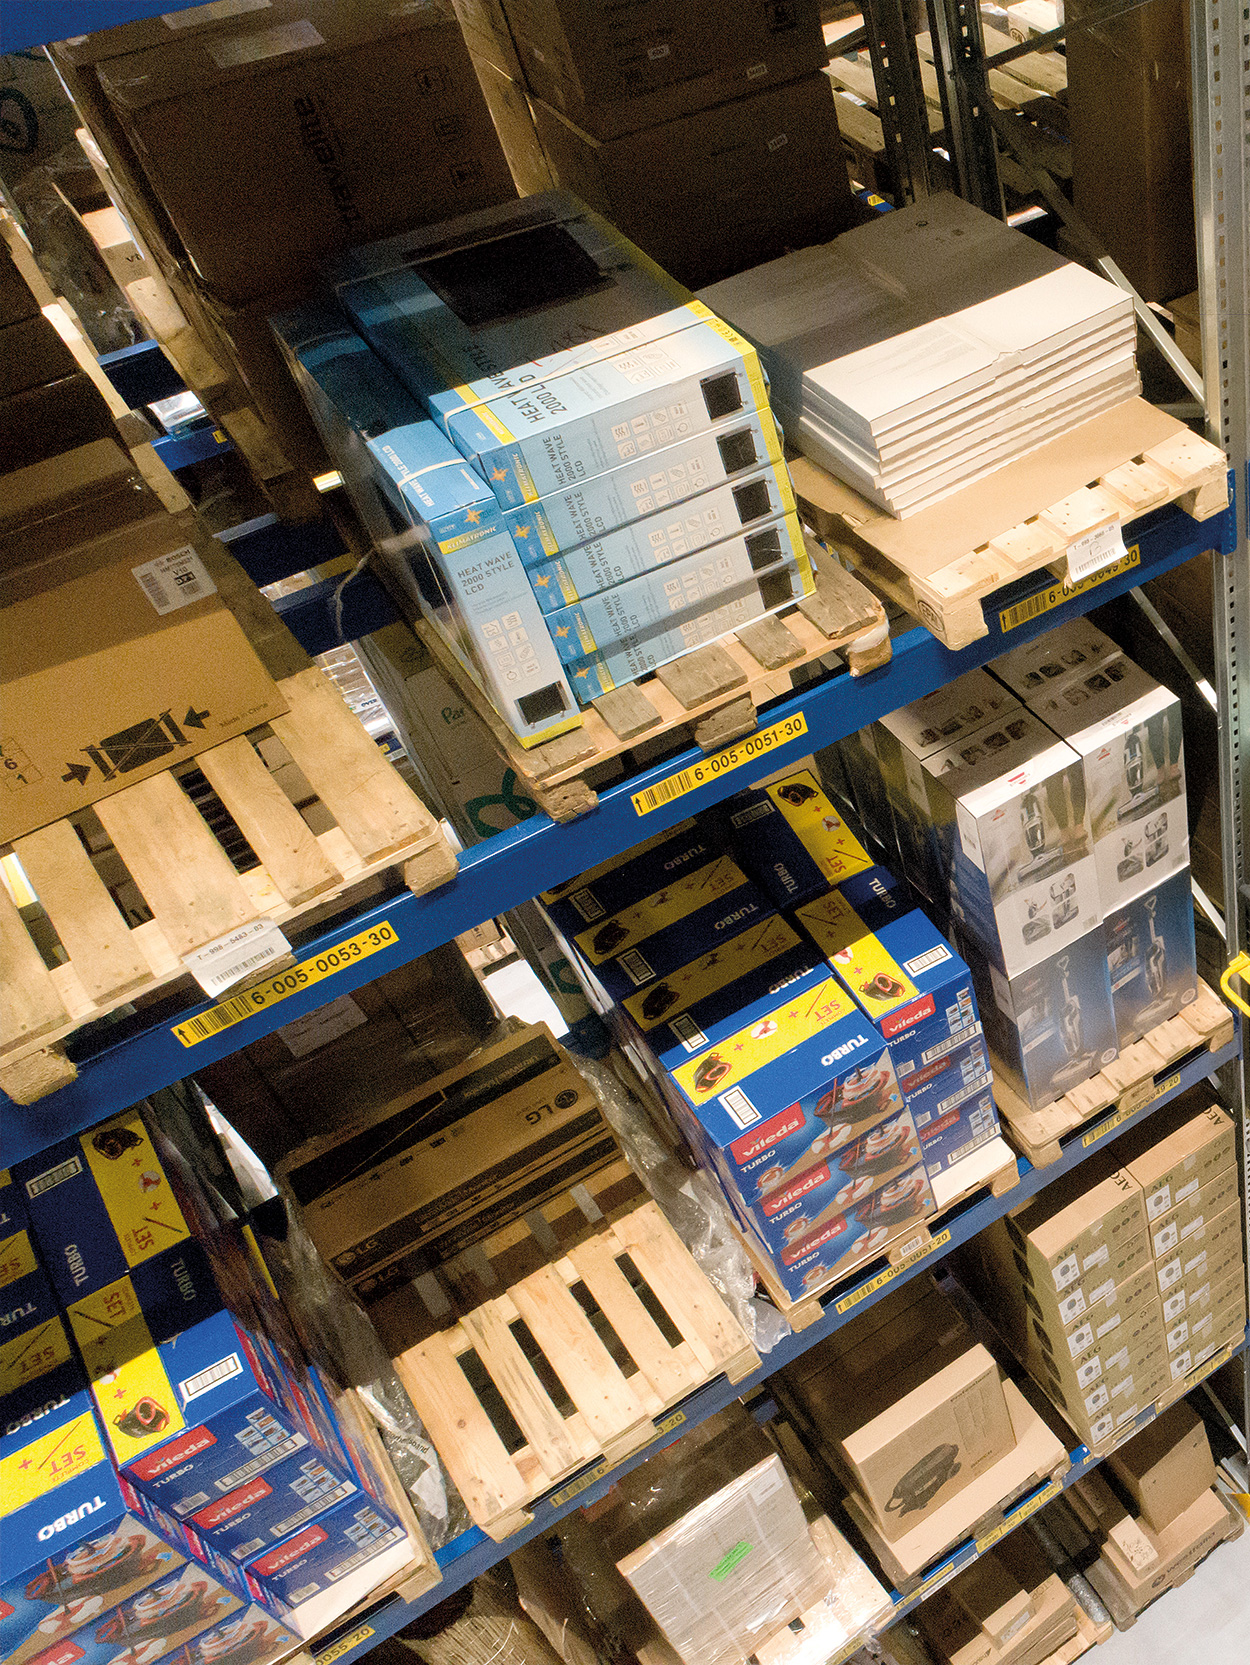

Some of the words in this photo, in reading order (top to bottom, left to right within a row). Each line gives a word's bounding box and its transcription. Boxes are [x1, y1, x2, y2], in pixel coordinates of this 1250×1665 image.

[519, 374, 546, 394] LD
[511, 397, 545, 423] HEAT
[536, 392, 568, 414] 2000
[543, 437, 557, 462] WAVE
[553, 434, 569, 461] STYLE
[552, 462, 566, 485] HEAT
[563, 463, 577, 481] 2000
[575, 461, 586, 477] LCD
[564, 494, 579, 518] WAVE
[574, 492, 589, 519] STYLE
[573, 518, 586, 540] HEAT
[584, 519, 597, 537] 2000
[594, 516, 606, 534] LCD
[447, 526, 497, 549] KLIMATRONIC
[457, 563, 482, 578] HEAT
[485, 551, 513, 567] WAVE
[584, 545, 598, 568] WAVE
[593, 542, 608, 567] STYLE
[461, 574, 484, 587] 2000
[486, 561, 515, 577] STYLE
[603, 567, 616, 586] 2000
[613, 565, 625, 581] LCD
[465, 584, 485, 595] LCD
[602, 597, 615, 618] WAVE
[611, 593, 625, 616] STYLE
[610, 618, 621, 637] HEAT
[620, 616, 632, 633] 2000
[630, 614, 640, 629] LCD
[218, 717, 239, 728] Made
[248, 703, 269, 716] China
[694, 718, 802, 781] 6-005-0051-30
[4, 758, 18, 770] 6
[825, 855, 847, 873] SET
[868, 877, 897, 908] TURBO
[714, 903, 759, 930] TURBO
[251, 927, 392, 1005] 6-005-0053-30
[814, 1000, 841, 1021] SET
[888, 1007, 932, 1035] vileda
[821, 1034, 869, 1066] TURBO
[888, 1030, 917, 1047] TURBO
[905, 1084, 933, 1101] TURBO
[525, 1104, 555, 1125] LG
[741, 1117, 800, 1158] vileda
[740, 1150, 777, 1173] TURBO
[769, 1172, 826, 1210] vileda
[1151, 1175, 1173, 1193] AEG
[769, 1202, 803, 1224] TURBO
[1157, 1213, 1179, 1230] AEG
[131, 1225, 155, 1251] SET
[358, 1240, 379, 1254] LG
[790, 1223, 844, 1259] vileda
[787, 1252, 820, 1273] TURBO
[1056, 1244, 1080, 1263] AEG
[1163, 1250, 1183, 1265] AEG
[64, 1244, 89, 1288] TURBO
[378, 1267, 399, 1281] LG
[171, 1258, 196, 1301] TURBO
[1063, 1278, 1085, 1298] AEG
[102, 1290, 127, 1320] SET
[1080, 1346, 1101, 1365] AEG
[49, 1445, 87, 1476] SET
[148, 1437, 210, 1474] vileda
[152, 1464, 194, 1488] TURBO
[207, 1488, 266, 1524] vileda
[37, 1496, 107, 1542] TURBO
[212, 1513, 252, 1536] TURBO
[267, 1534, 322, 1571] vileda
[271, 1559, 307, 1582] TURBO
